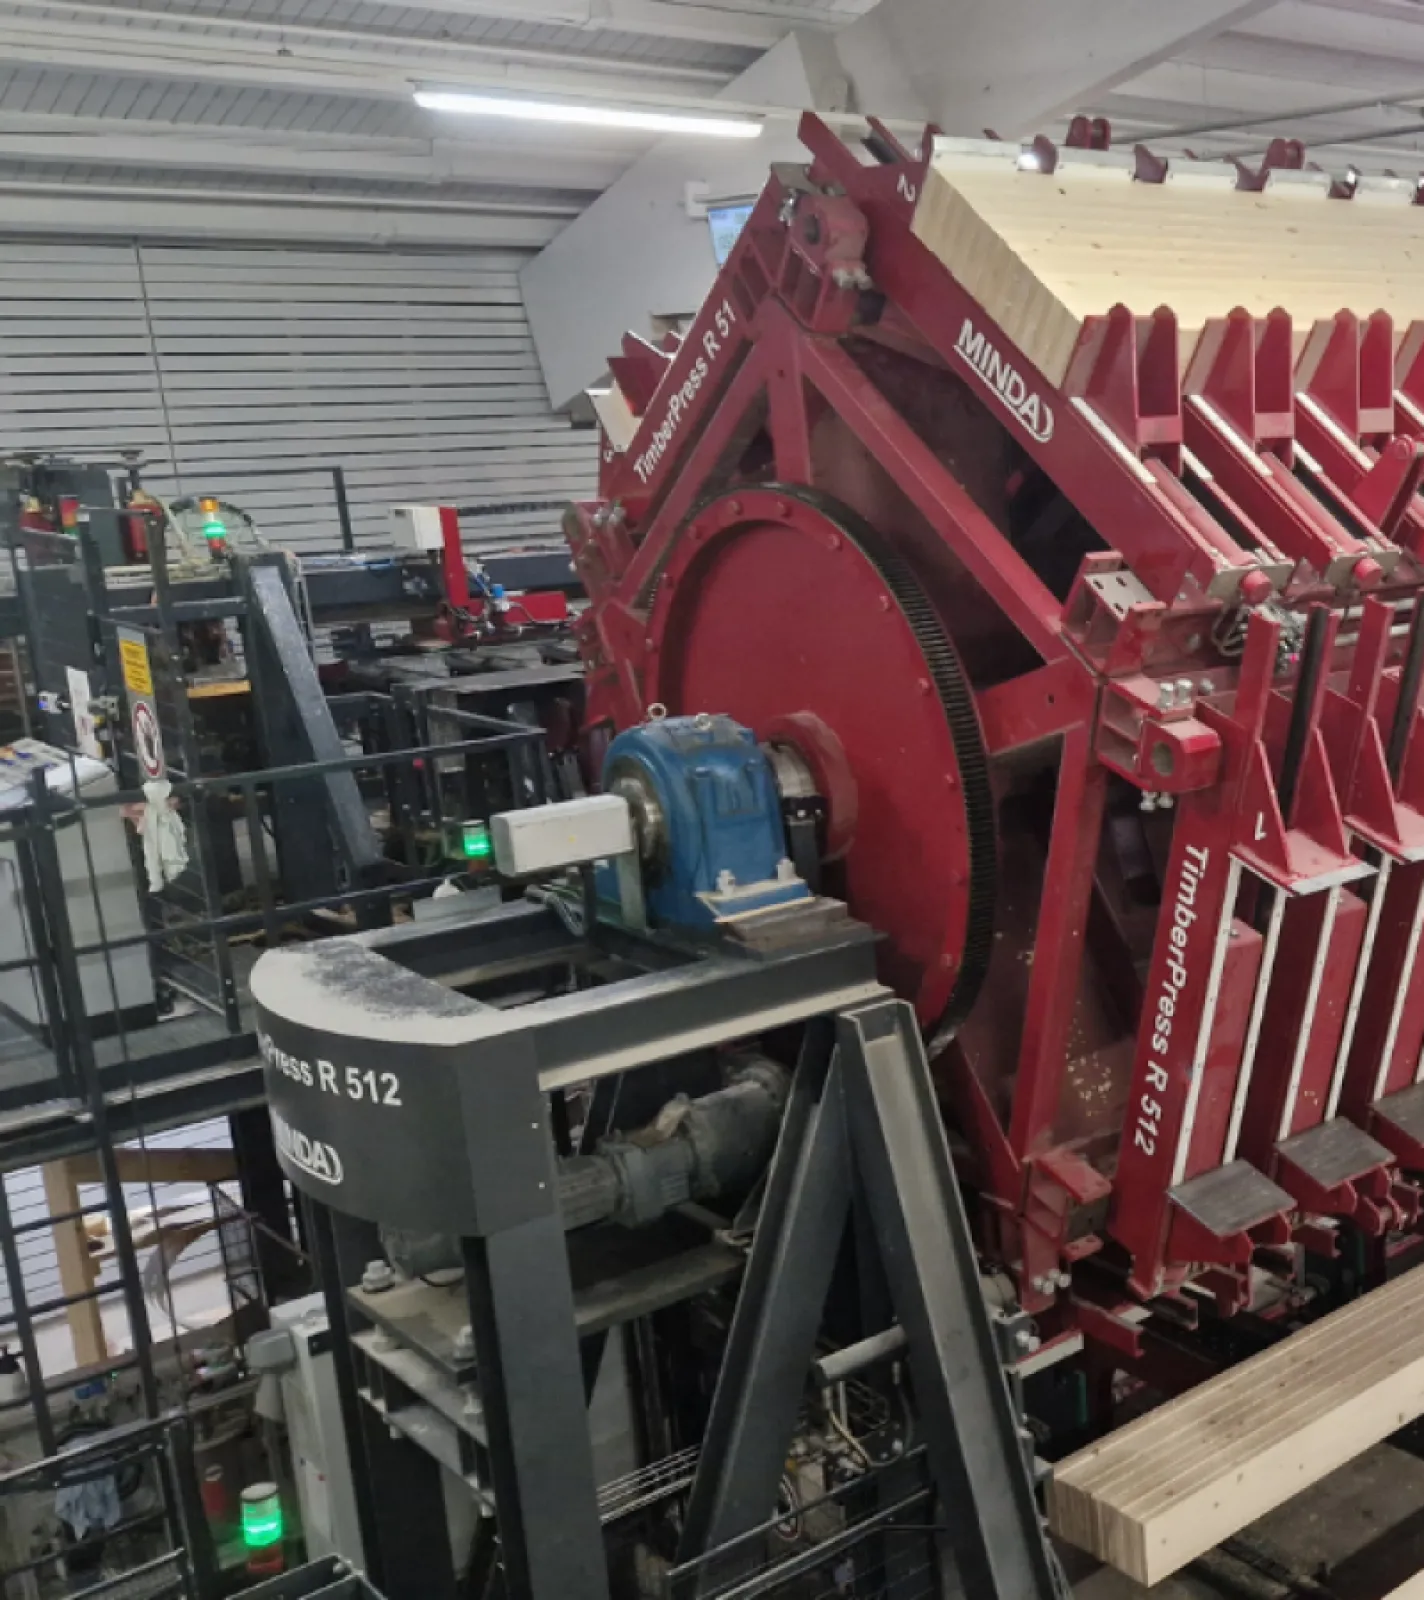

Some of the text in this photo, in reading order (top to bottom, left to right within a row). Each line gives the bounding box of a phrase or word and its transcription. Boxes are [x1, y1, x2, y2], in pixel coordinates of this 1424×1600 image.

[896, 173, 916, 202] 2
[633, 299, 737, 484] TimberPress R 51
[953, 318, 1054, 443] MINDA
[1254, 811, 1267, 841] 1
[1134, 844, 1209, 1156] TimberPress R 512
[257, 1032, 403, 1106] Press R 512
